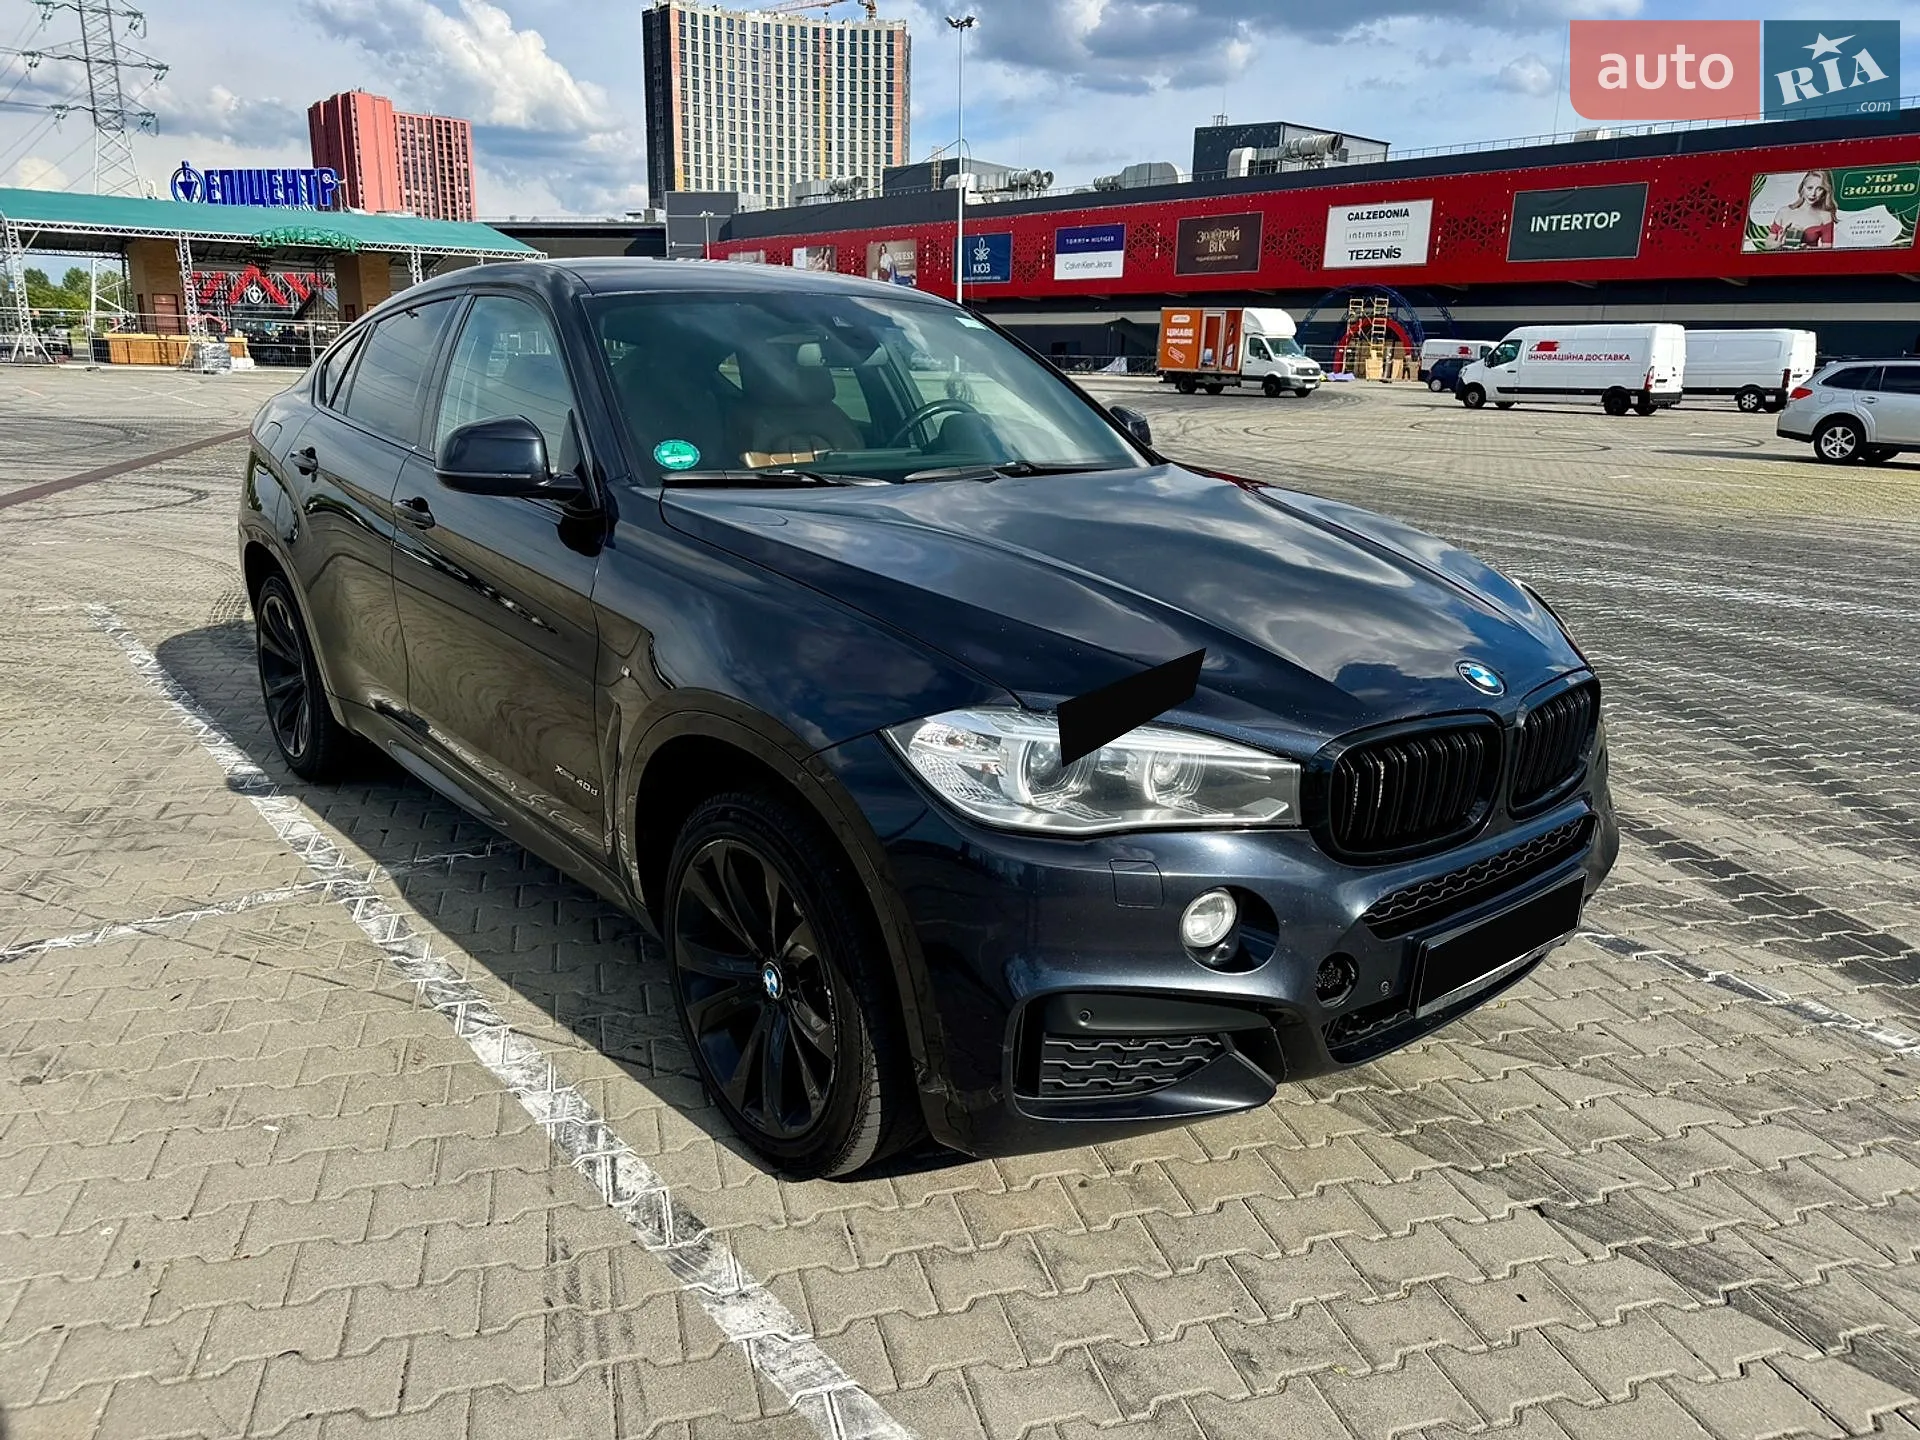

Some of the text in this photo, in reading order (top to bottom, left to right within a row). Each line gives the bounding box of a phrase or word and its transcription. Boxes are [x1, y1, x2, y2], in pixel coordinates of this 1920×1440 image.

[1865, 173, 1898, 184] УКР
[203, 168, 336, 207] ЕПІЦЕНТР
[1844, 182, 1915, 195] ЗОЛОТО
[1347, 208, 1410, 221] CALZEDONIA
[1530, 211, 1621, 232] INTERTOP
[1349, 229, 1405, 239] intimissimi
[1528, 352, 1631, 362] ІННОВАЦІЙНА ДОСТАВКА
